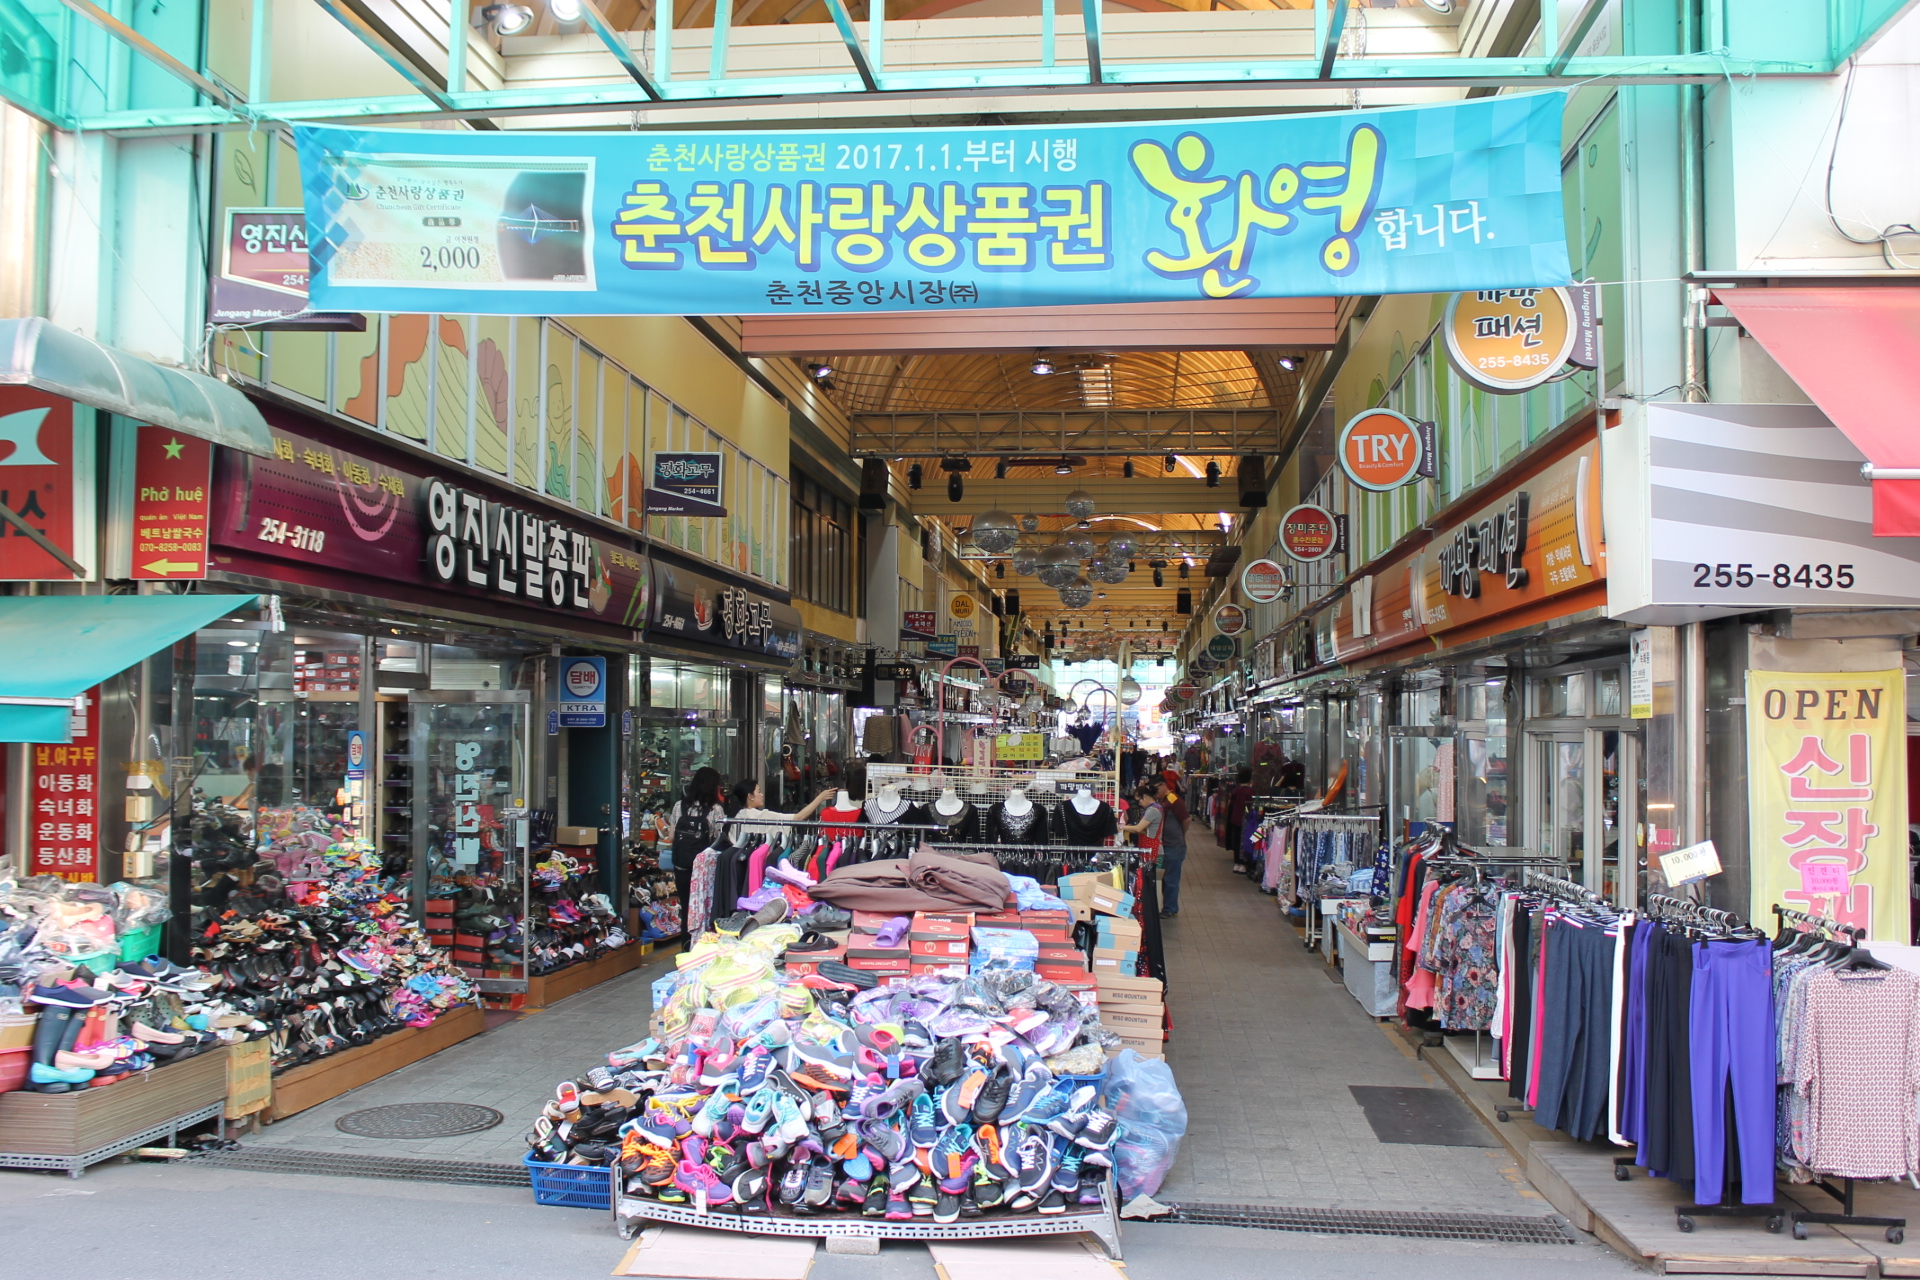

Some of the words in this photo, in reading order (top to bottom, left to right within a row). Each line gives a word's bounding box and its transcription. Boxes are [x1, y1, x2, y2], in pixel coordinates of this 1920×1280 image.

[646, 142, 826, 173] 춘천사랑상품권
[836, 139, 1016, 173] 2017.1.1.부터
[1024, 137, 1078, 172] 시행
[375, 185, 464, 202] 춘천사랑상품권
[1129, 124, 1386, 298] 환영
[612, 181, 1111, 272] 춘천사랑상품권
[1373, 200, 1496, 252] 합니다.
[420, 246, 481, 273] 2,000
[765, 279, 979, 306] 춘천중앙시장(주)
[214, 309, 251, 319] Jungang
[252, 309, 282, 318] Market
[1473, 314, 1543, 348] 패션
[1478, 353, 1550, 369] 255-8435
[1351, 433, 1410, 463] TRY
[303, 447, 335, 476] 숙녀화
[343, 460, 371, 488] 아동화
[378, 472, 405, 499] 수제화
[659, 460, 715, 479] 평화고무
[683, 487, 715, 495] 254-4661
[139, 527, 204, 540] 베트남쌀국수
[257, 516, 326, 554] 254-3118
[1286, 523, 1330, 535] 장미주단
[139, 543, 202, 552] 070-8258-0083
[428, 478, 592, 611] 영진신발총판
[1438, 491, 1529, 600] 까망패션
[1692, 563, 1855, 589] 255-8435
[955, 600, 970, 608] DAL
[722, 584, 773, 648] 평화고무
[569, 670, 596, 685] 담배
[566, 704, 598, 712] KTRA
[1764, 688, 1884, 721] OPEN
[915, 744, 933, 758] TRY
[38, 773, 94, 793] 아동화
[38, 798, 94, 817] 숙녀화
[38, 822, 94, 842] 운동화
[37, 847, 93, 867] 등산화
